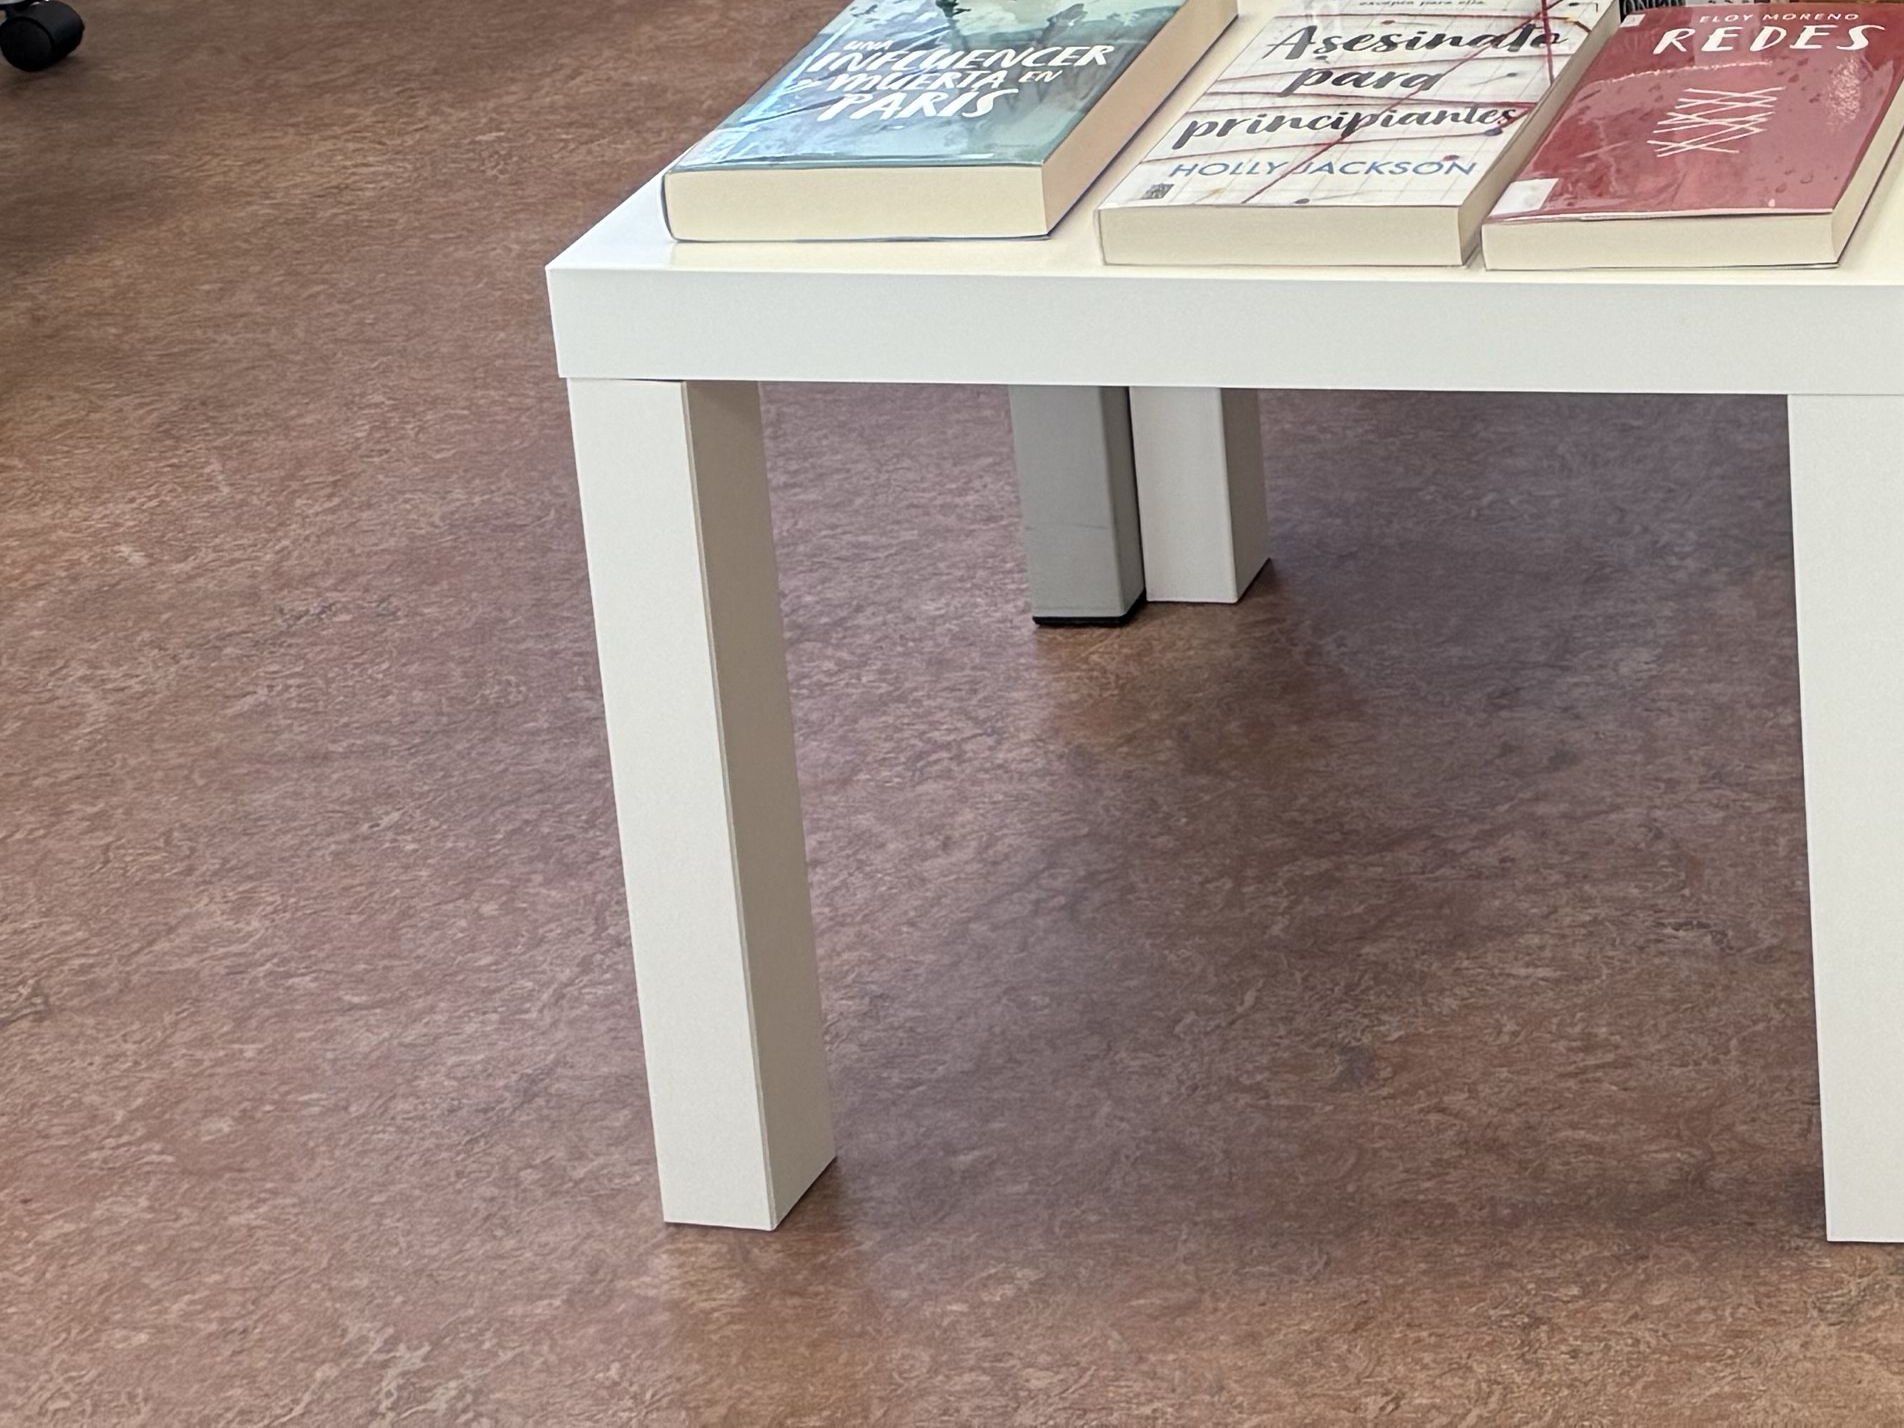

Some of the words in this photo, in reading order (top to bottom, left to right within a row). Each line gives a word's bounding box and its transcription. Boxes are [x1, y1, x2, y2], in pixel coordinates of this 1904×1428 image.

[1699, 14, 1754, 24] ELOY
[1762, 11, 1860, 22] MORENO
[843, 40, 895, 52] UNA
[1261, 22, 1568, 61] Asesinato
[1653, 24, 1886, 55] REDES
[807, 44, 1117, 73] INFLUENCER
[826, 70, 1009, 92] MUERTA
[1018, 70, 1064, 84] EN
[1278, 64, 1446, 98] para
[817, 85, 1022, 122] PARÍS
[1171, 102, 1518, 151] principiantes
[1167, 161, 1292, 178] HOLLY
[1292, 160, 1478, 177] JACKSON
